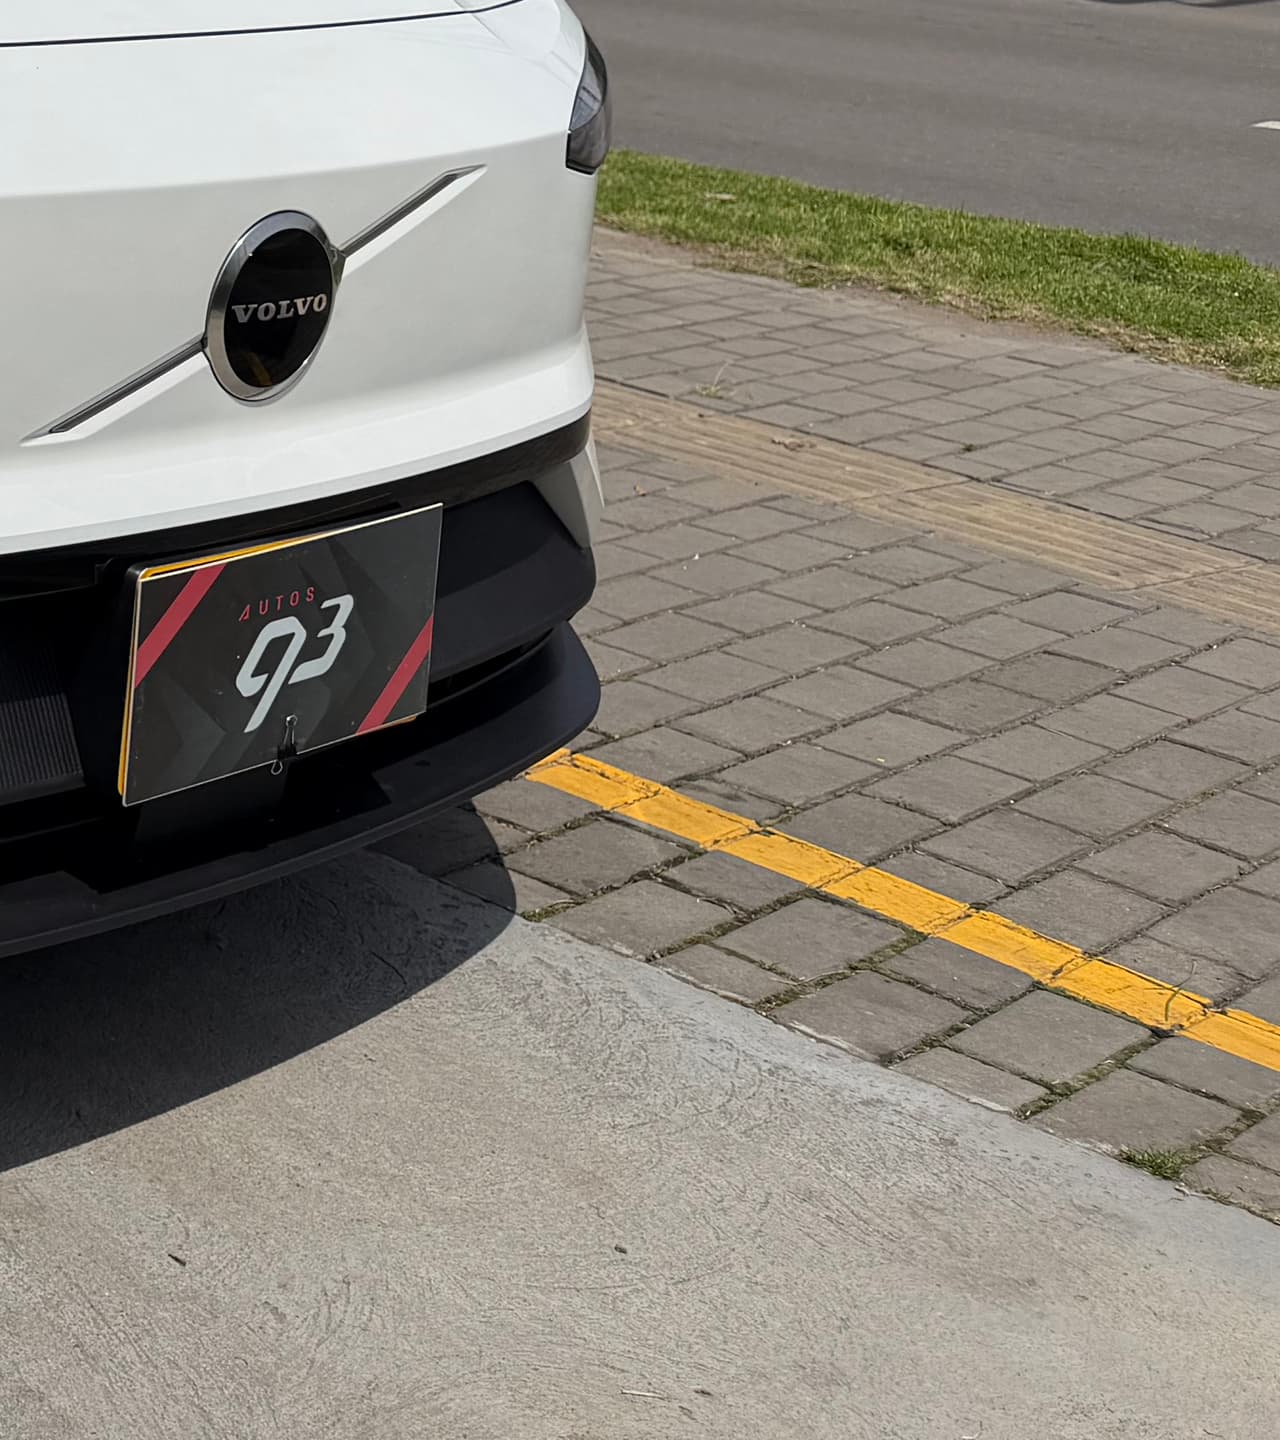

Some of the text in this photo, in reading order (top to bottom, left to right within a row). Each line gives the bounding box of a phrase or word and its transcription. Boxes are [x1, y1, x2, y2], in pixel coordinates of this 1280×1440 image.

[232, 294, 327, 323] VOLVO
[239, 587, 315, 622] AUTOS
[236, 594, 354, 733] 93
